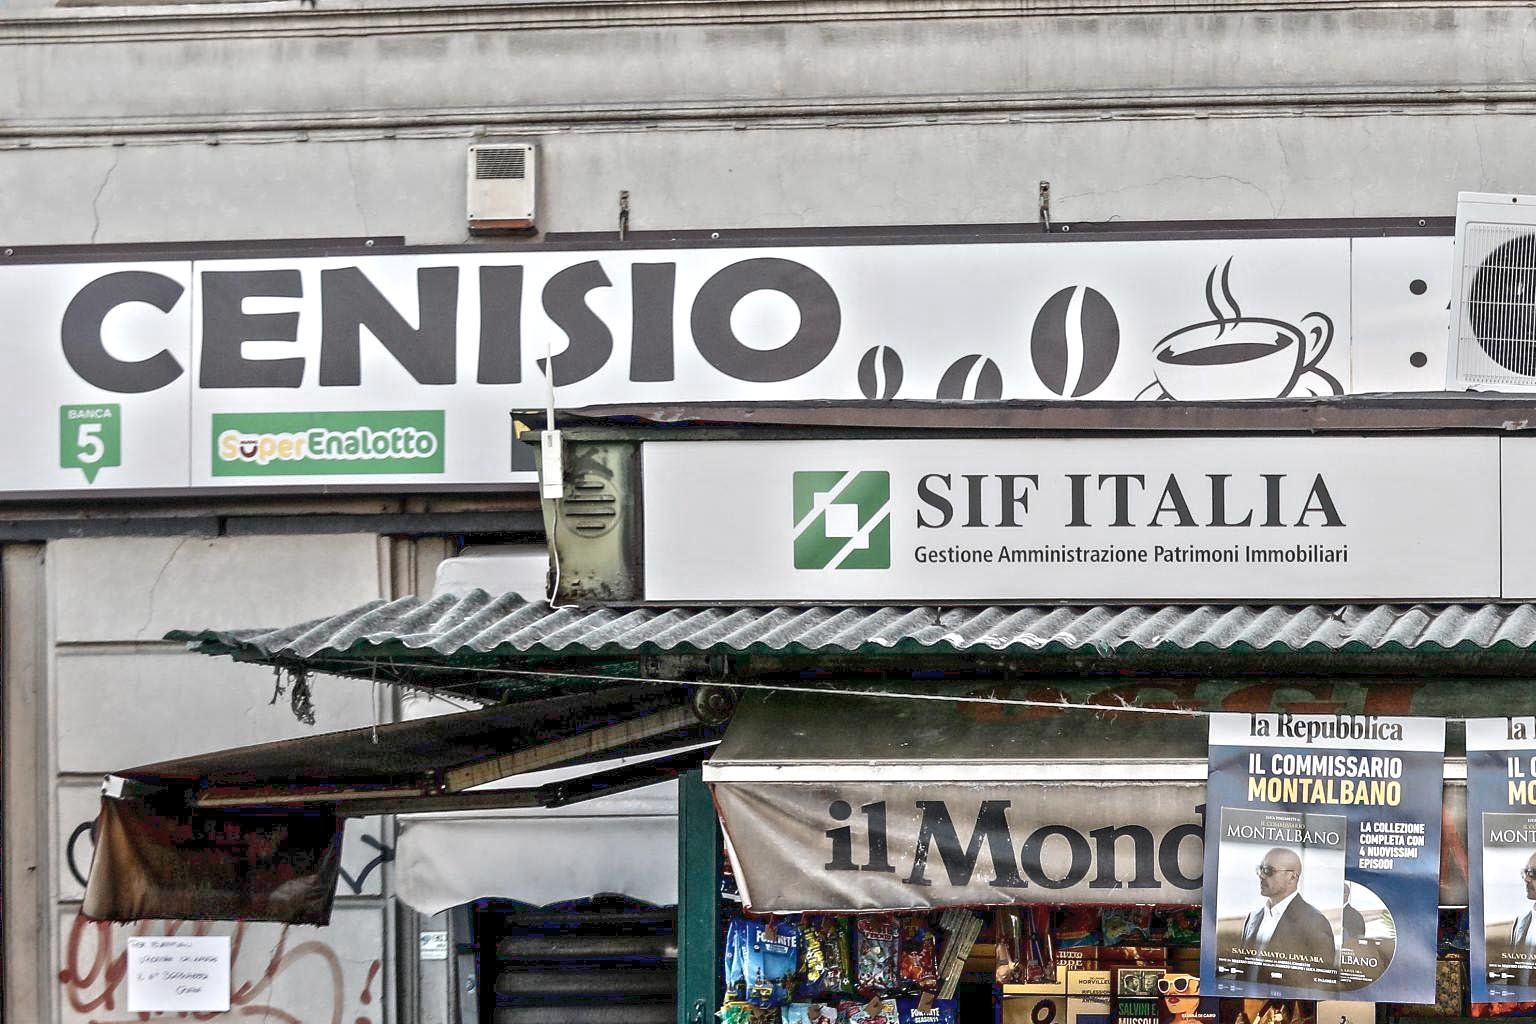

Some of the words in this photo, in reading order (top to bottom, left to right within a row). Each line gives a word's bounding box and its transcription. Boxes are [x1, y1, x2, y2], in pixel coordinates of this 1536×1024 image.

[60, 256, 842, 394] CENISIO
[76, 423, 104, 463] 5
[916, 473, 1040, 529] SIF
[1063, 472, 1347, 528] ITALIA
[914, 546, 993, 564] Gestione
[998, 545, 1148, 564] Amministrazione
[1154, 545, 1239, 564] Patrimoni
[1245, 545, 1348, 563] Immobiliari
[1277, 713, 1403, 744] Repubblica
[1248, 753, 1266, 775] IL
[1271, 753, 1402, 778] COMMISSARIO
[1507, 757, 1525, 778] IL
[1248, 777, 1401, 806] MONTALBANO
[824, 799, 896, 873] il
[1227, 825, 1340, 846] MONTALBANO
[1360, 821, 1371, 833] LA
[1374, 822, 1425, 834] COLLEZIONE
[1360, 834, 1405, 846] COMPLETA
[1406, 836, 1425, 847] CON
[1359, 847, 1366, 856] 4
[1367, 847, 1418, 859] NUOVISSIMI
[1359, 858, 1393, 870] EPISODI
[1118, 1002, 1149, 1016] SALVINI
